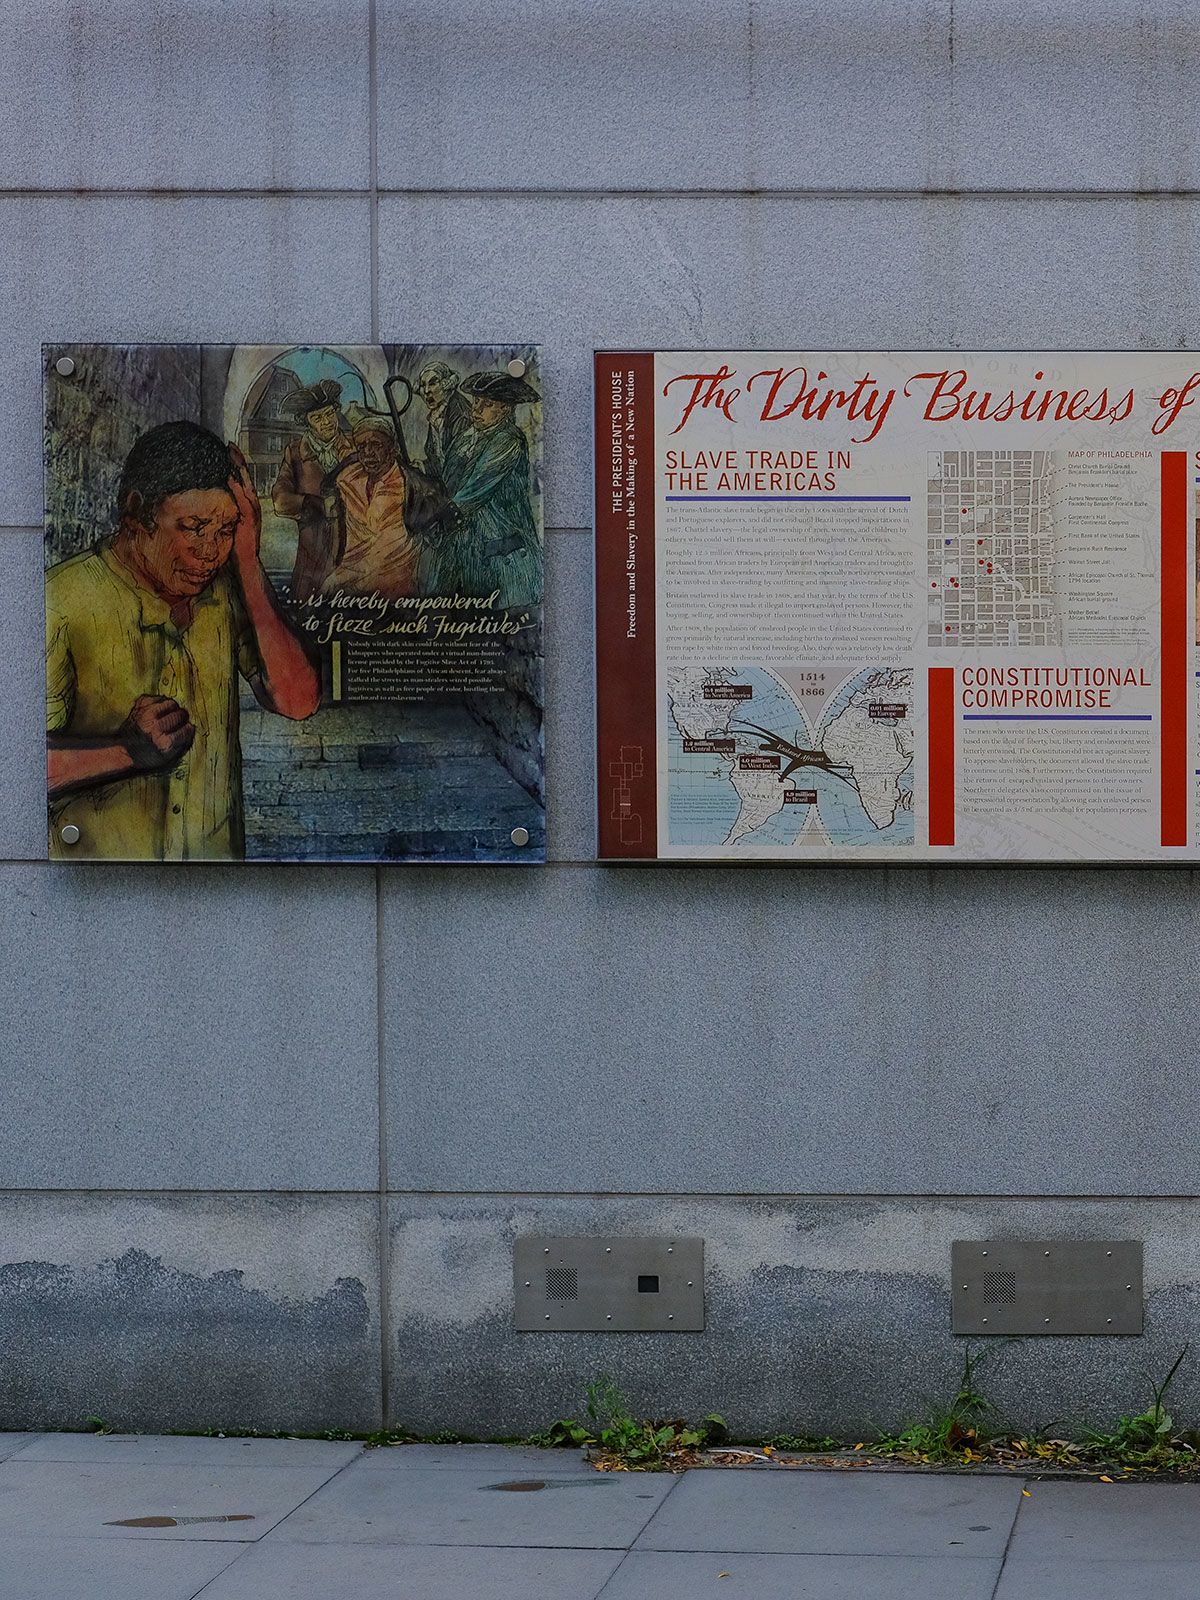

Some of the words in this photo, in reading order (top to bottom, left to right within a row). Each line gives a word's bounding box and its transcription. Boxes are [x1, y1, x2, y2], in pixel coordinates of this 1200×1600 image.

[612, 371, 622, 408] HOUSE
[626, 371, 635, 404] Nation
[663, 366, 740, 435] The
[747, 367, 895, 443] Dirty
[904, 370, 1134, 425] Business
[626, 409, 635, 431] New
[612, 413, 622, 486] PRESIDENT'S
[626, 443, 635, 455] of
[666, 451, 738, 469] SLAVE
[746, 451, 818, 468] TRADE
[828, 451, 851, 468] IN
[626, 458, 638, 498] Making
[666, 473, 708, 491] THE
[717, 472, 836, 491] AMERICAS
[612, 491, 622, 513] THE
[626, 500, 635, 517] the
[626, 520, 635, 530] in
[626, 533, 639, 569] Slavery
[627, 573, 636, 591] and
[328, 590, 390, 620] hereby
[395, 589, 500, 618] empowered
[302, 616, 320, 631] to
[380, 615, 428, 633] such
[627, 594, 636, 638] Freedom
[962, 668, 1151, 686] CONSTITUTIONAL
[801, 688, 824, 696] 1866
[962, 690, 1111, 707] COMPROMISE
